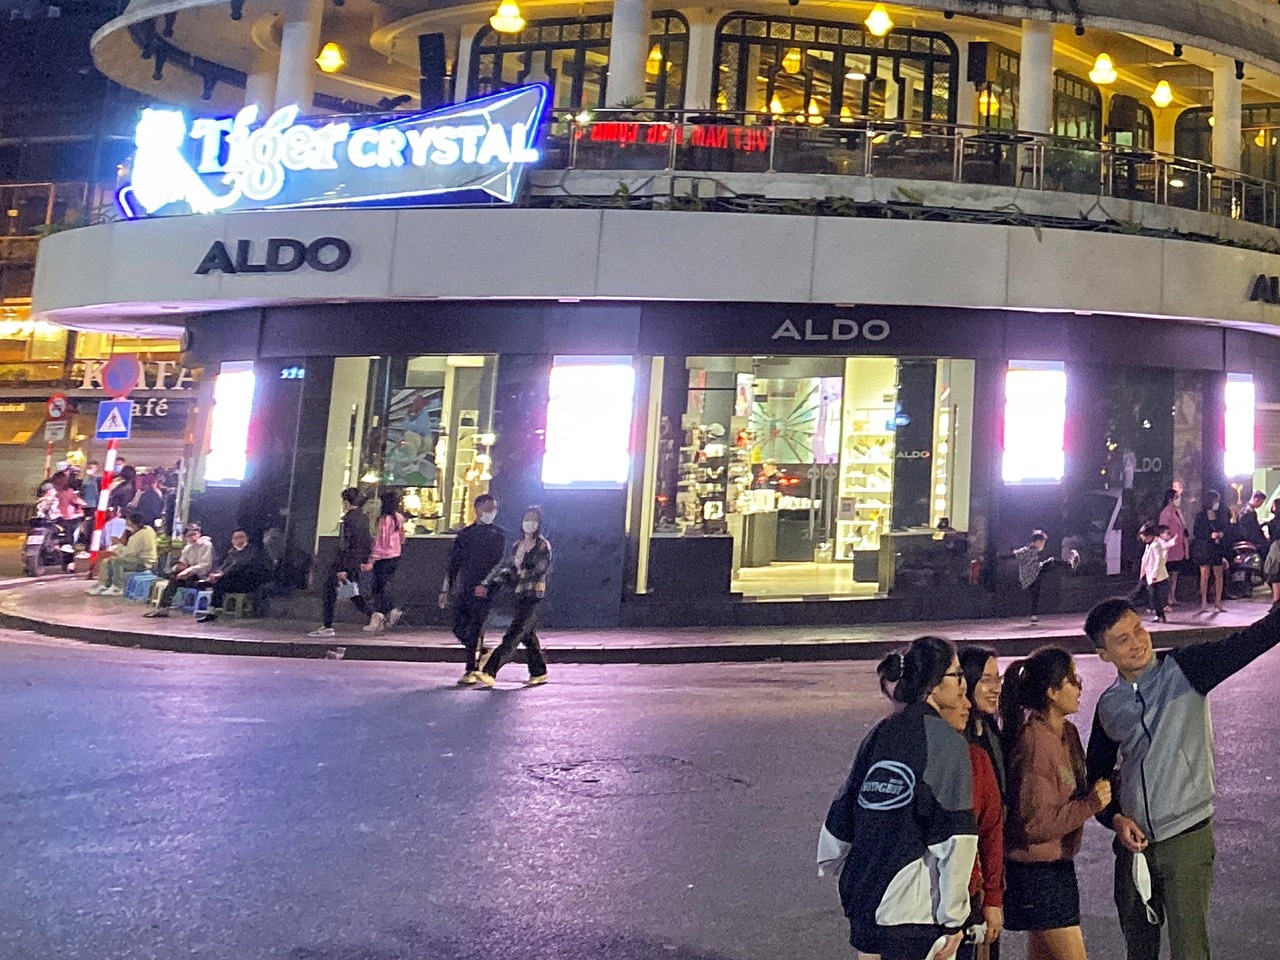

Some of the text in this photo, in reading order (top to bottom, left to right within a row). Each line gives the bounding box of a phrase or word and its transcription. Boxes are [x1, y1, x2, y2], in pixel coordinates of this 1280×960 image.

[190, 103, 541, 201] Tiger CRYSTAL
[193, 236, 352, 275] ALDO
[771, 318, 891, 341] ALDO
[131, 398, 169, 417] afé
[896, 450, 931, 459] ALDO
